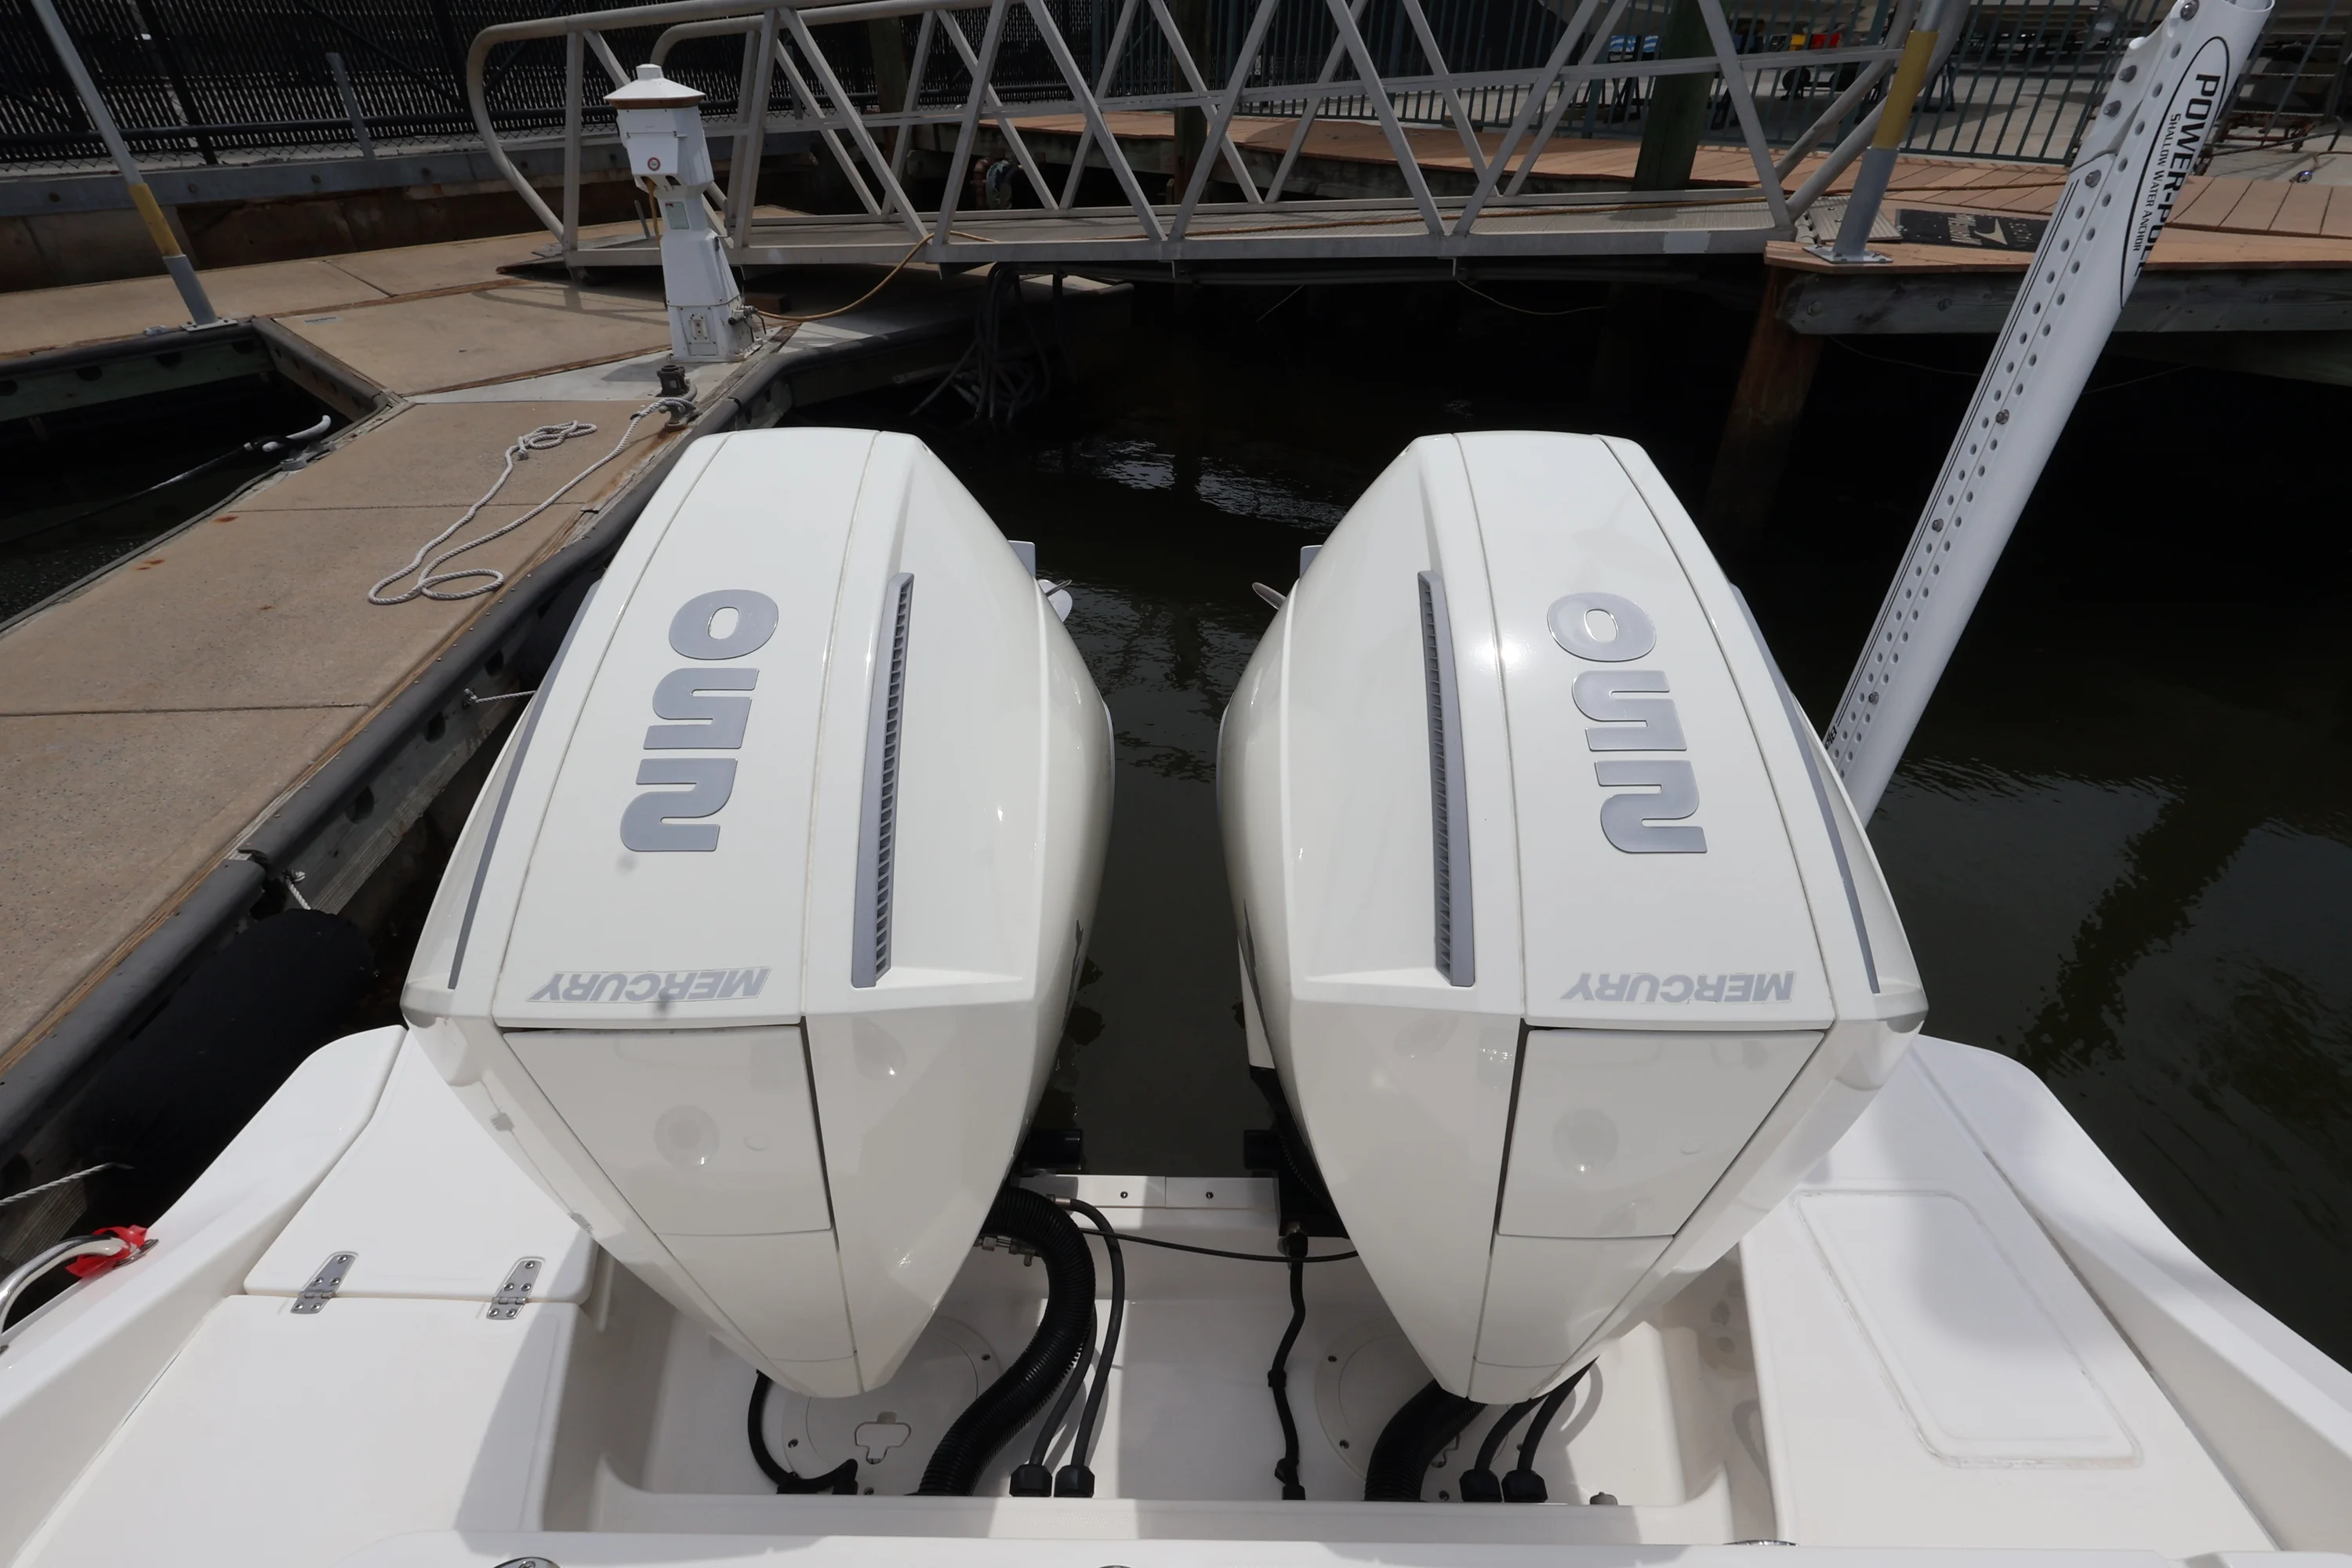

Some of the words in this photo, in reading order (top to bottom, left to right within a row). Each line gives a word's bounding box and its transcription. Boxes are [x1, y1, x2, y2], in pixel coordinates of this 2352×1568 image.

[2158, 113, 2181, 167] SHALLOW
[2145, 169, 2165, 207] WATER
[2132, 210, 2154, 252] ANCHOR
[620, 589, 779, 852] 250
[1547, 592, 1708, 854] 250
[527, 967, 771, 1002] MERCURY
[1560, 972, 1794, 1003] MERCURY
